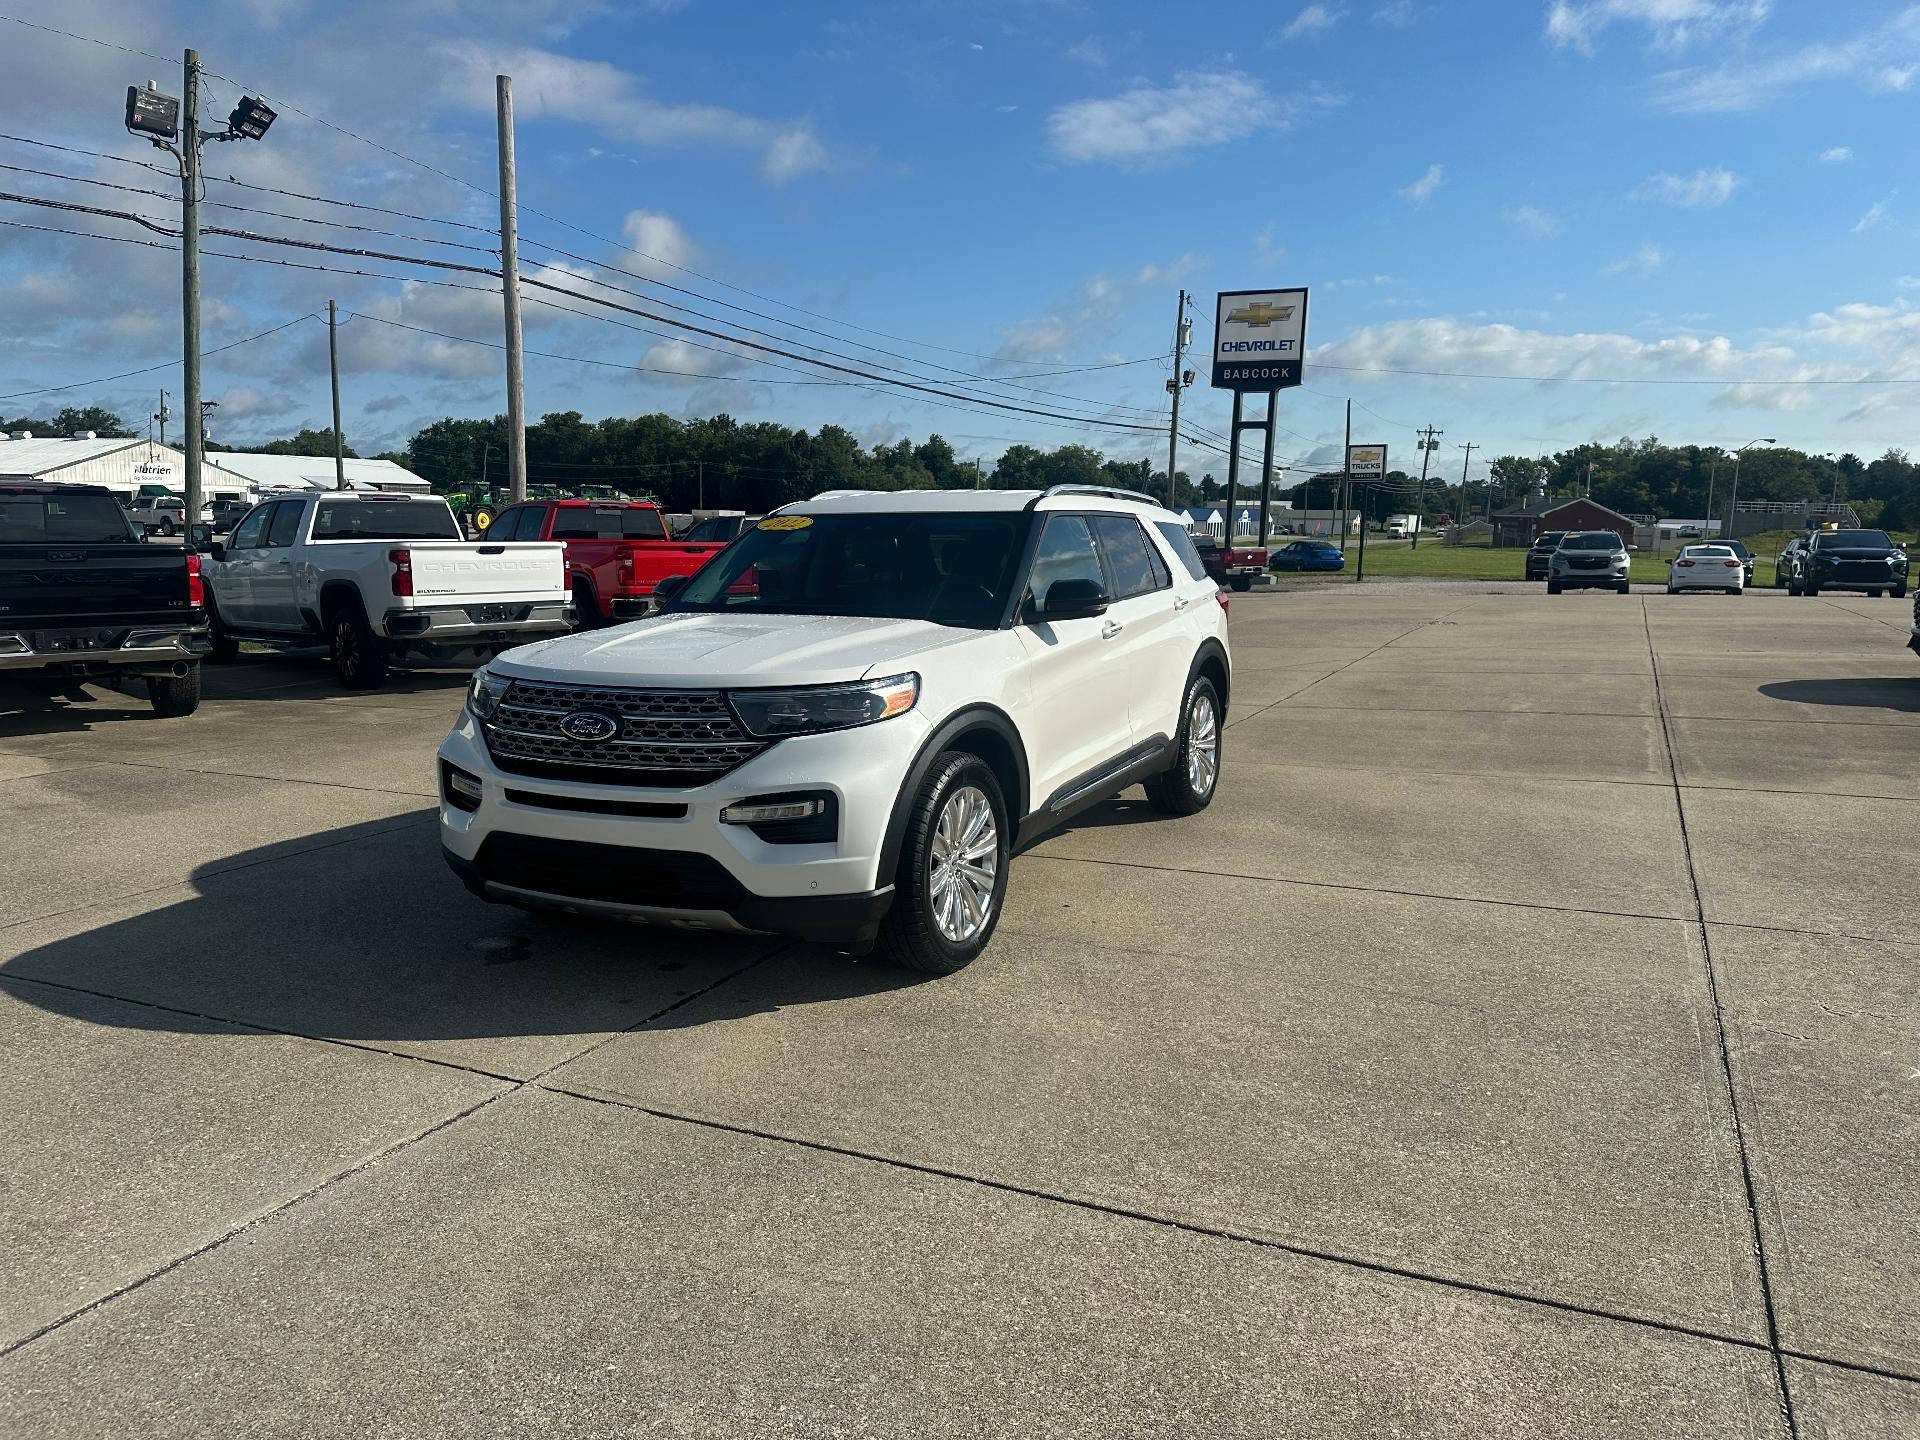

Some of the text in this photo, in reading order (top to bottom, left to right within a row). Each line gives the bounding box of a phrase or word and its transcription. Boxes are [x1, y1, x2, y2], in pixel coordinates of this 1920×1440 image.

[1221, 340, 1295, 352] CHEVROLET
[1223, 368, 1289, 379] BABCOCK
[134, 465, 171, 474] Nutrien
[424, 560, 554, 573] CHEVROLET
[571, 717, 601, 733] Ford
